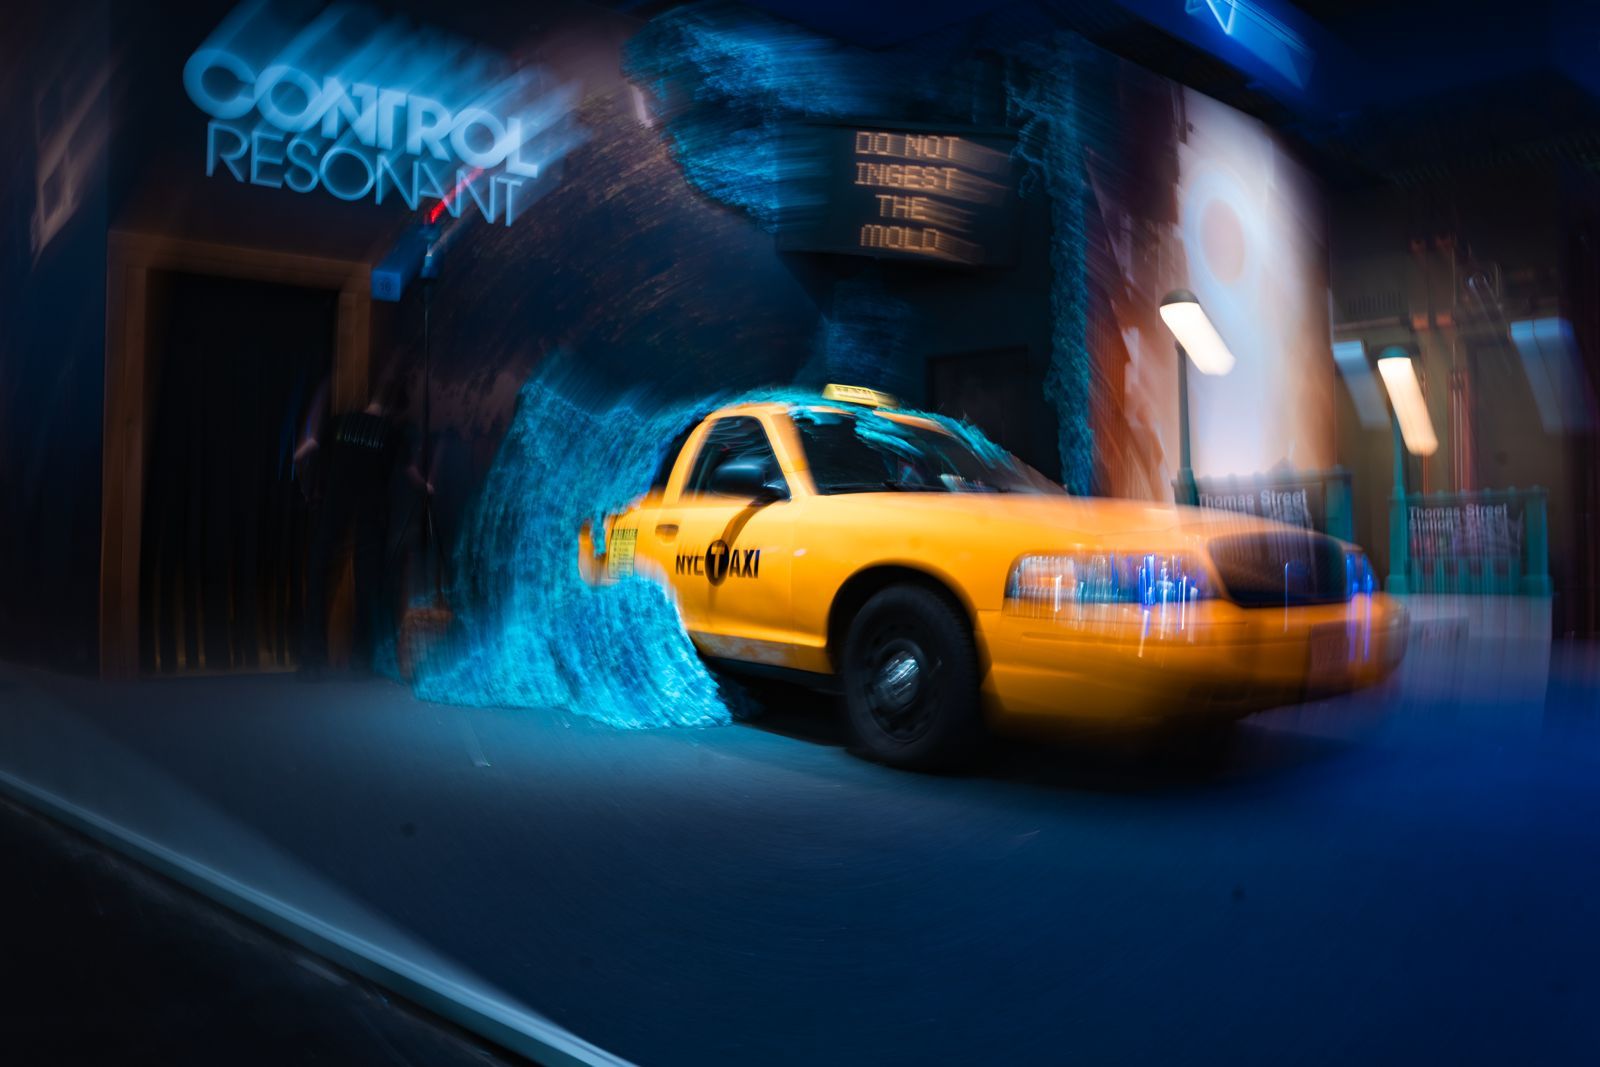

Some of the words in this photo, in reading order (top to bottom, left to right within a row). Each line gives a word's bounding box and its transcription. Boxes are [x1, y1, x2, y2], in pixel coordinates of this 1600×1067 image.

[183, 49, 539, 179] CONTROL
[855, 131, 890, 155] DO
[904, 134, 960, 159] NOT
[205, 119, 523, 227] RESONANT
[854, 162, 958, 190] INGEST
[875, 194, 929, 220] THE
[860, 224, 941, 251] MOLD
[1198, 493, 1256, 508] Thomas
[1260, 488, 1307, 505] Street
[1408, 505, 1461, 520] Thomas
[1465, 502, 1508, 518] Street
[675, 554, 704, 576] NYC
